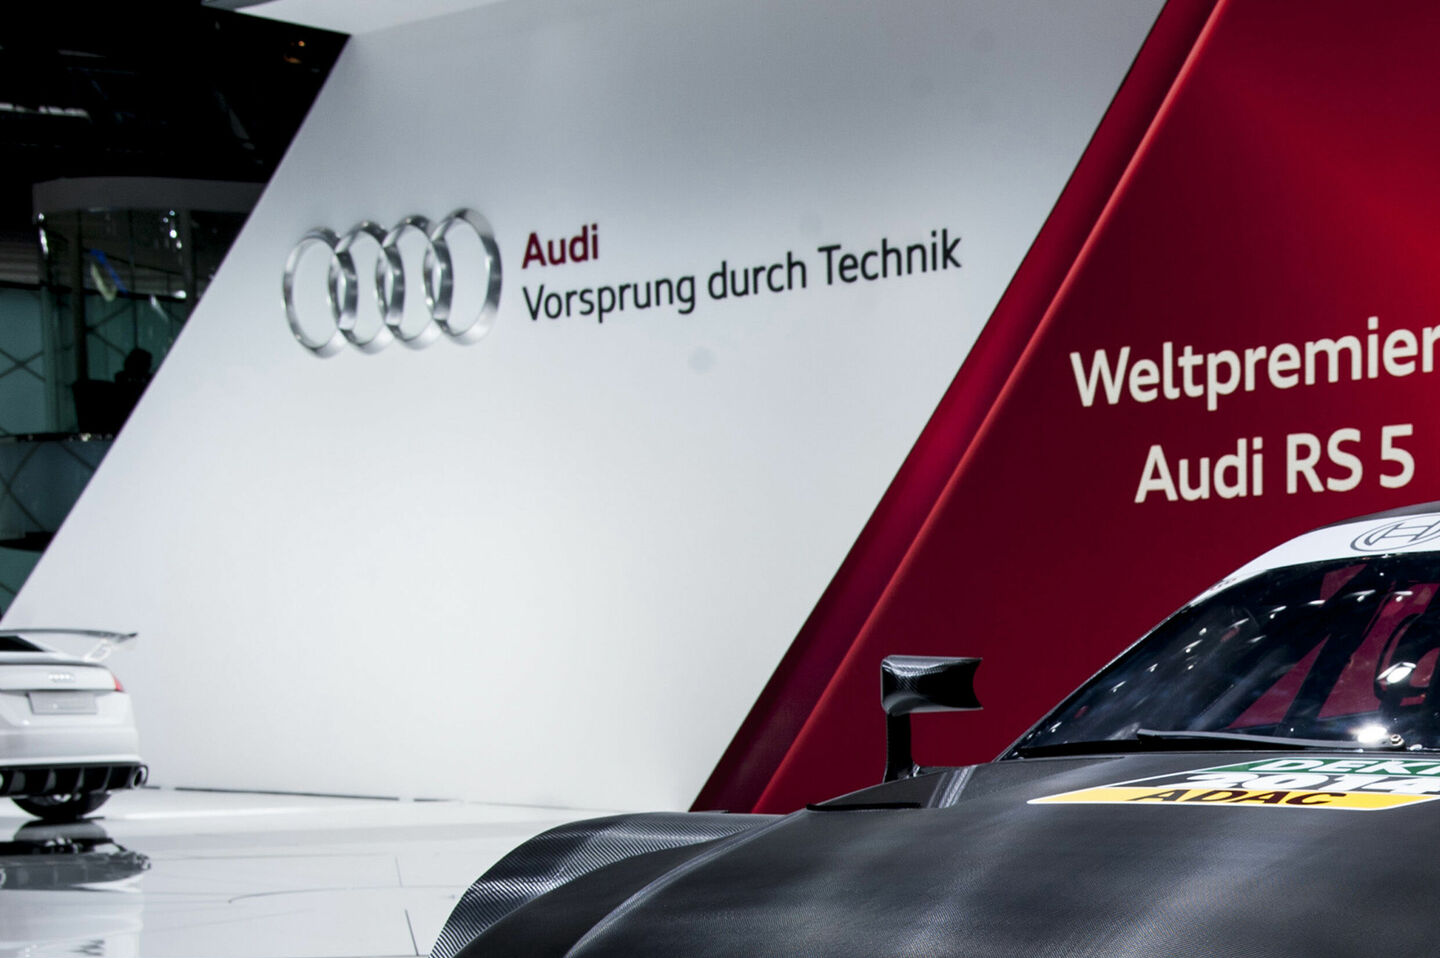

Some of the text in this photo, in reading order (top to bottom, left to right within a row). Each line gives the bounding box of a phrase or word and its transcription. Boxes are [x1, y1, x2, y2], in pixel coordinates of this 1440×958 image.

[521, 223, 600, 270] Audi
[522, 229, 962, 323] Vorsprung durch Technik
[1134, 437, 1264, 503] Audi
[1286, 427, 1364, 494] RS
[1379, 424, 1414, 489] 5
[1128, 789, 1347, 806] ADAC
